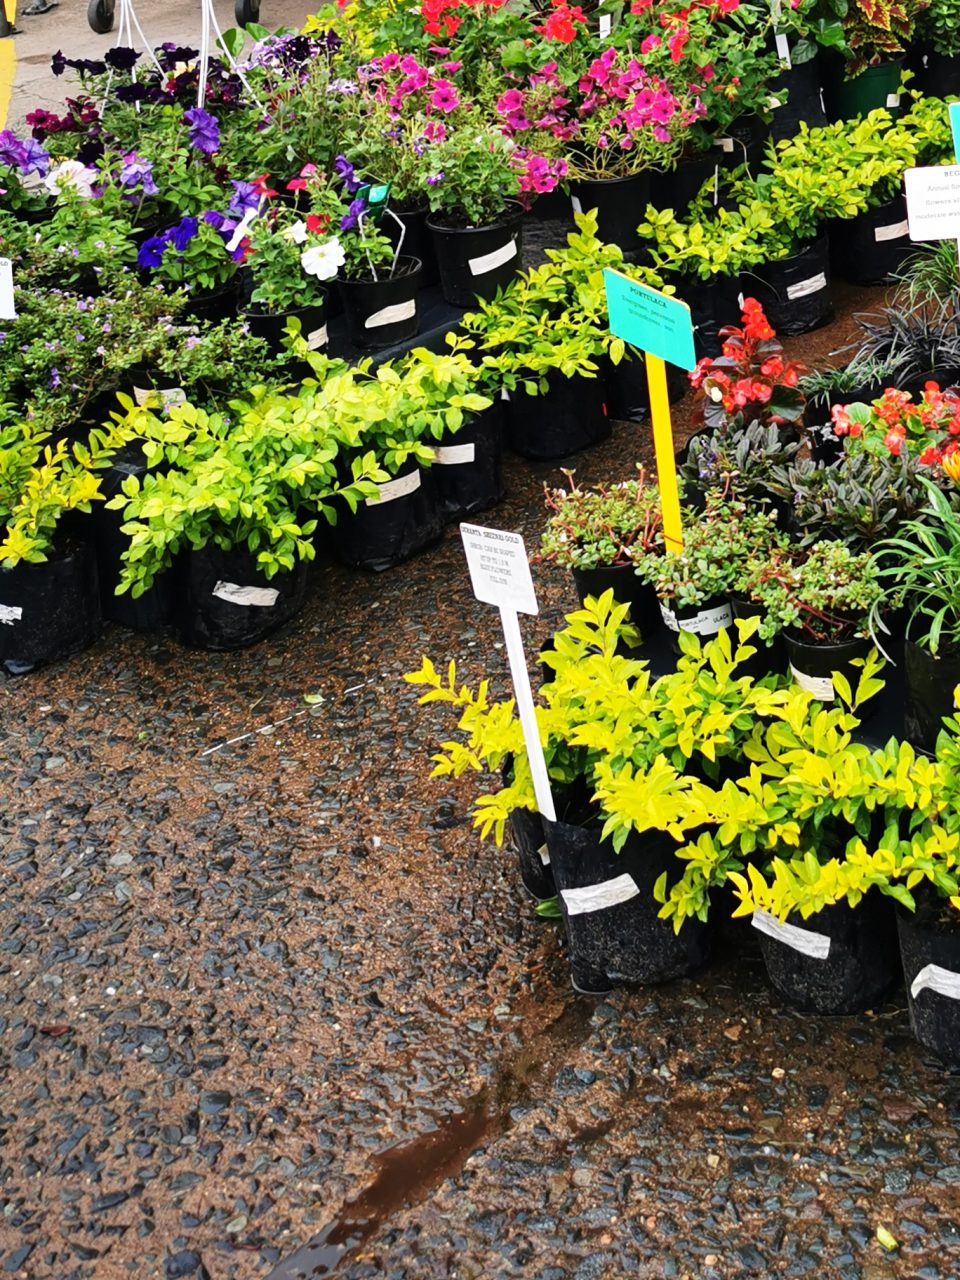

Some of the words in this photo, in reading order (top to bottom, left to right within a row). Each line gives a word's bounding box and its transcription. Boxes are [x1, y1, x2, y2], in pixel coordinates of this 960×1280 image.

[927, 184, 950, 192] Annual
[925, 198, 952, 206] flowers
[915, 212, 947, 220] moderate
[629, 286, 668, 309] PORTULACA
